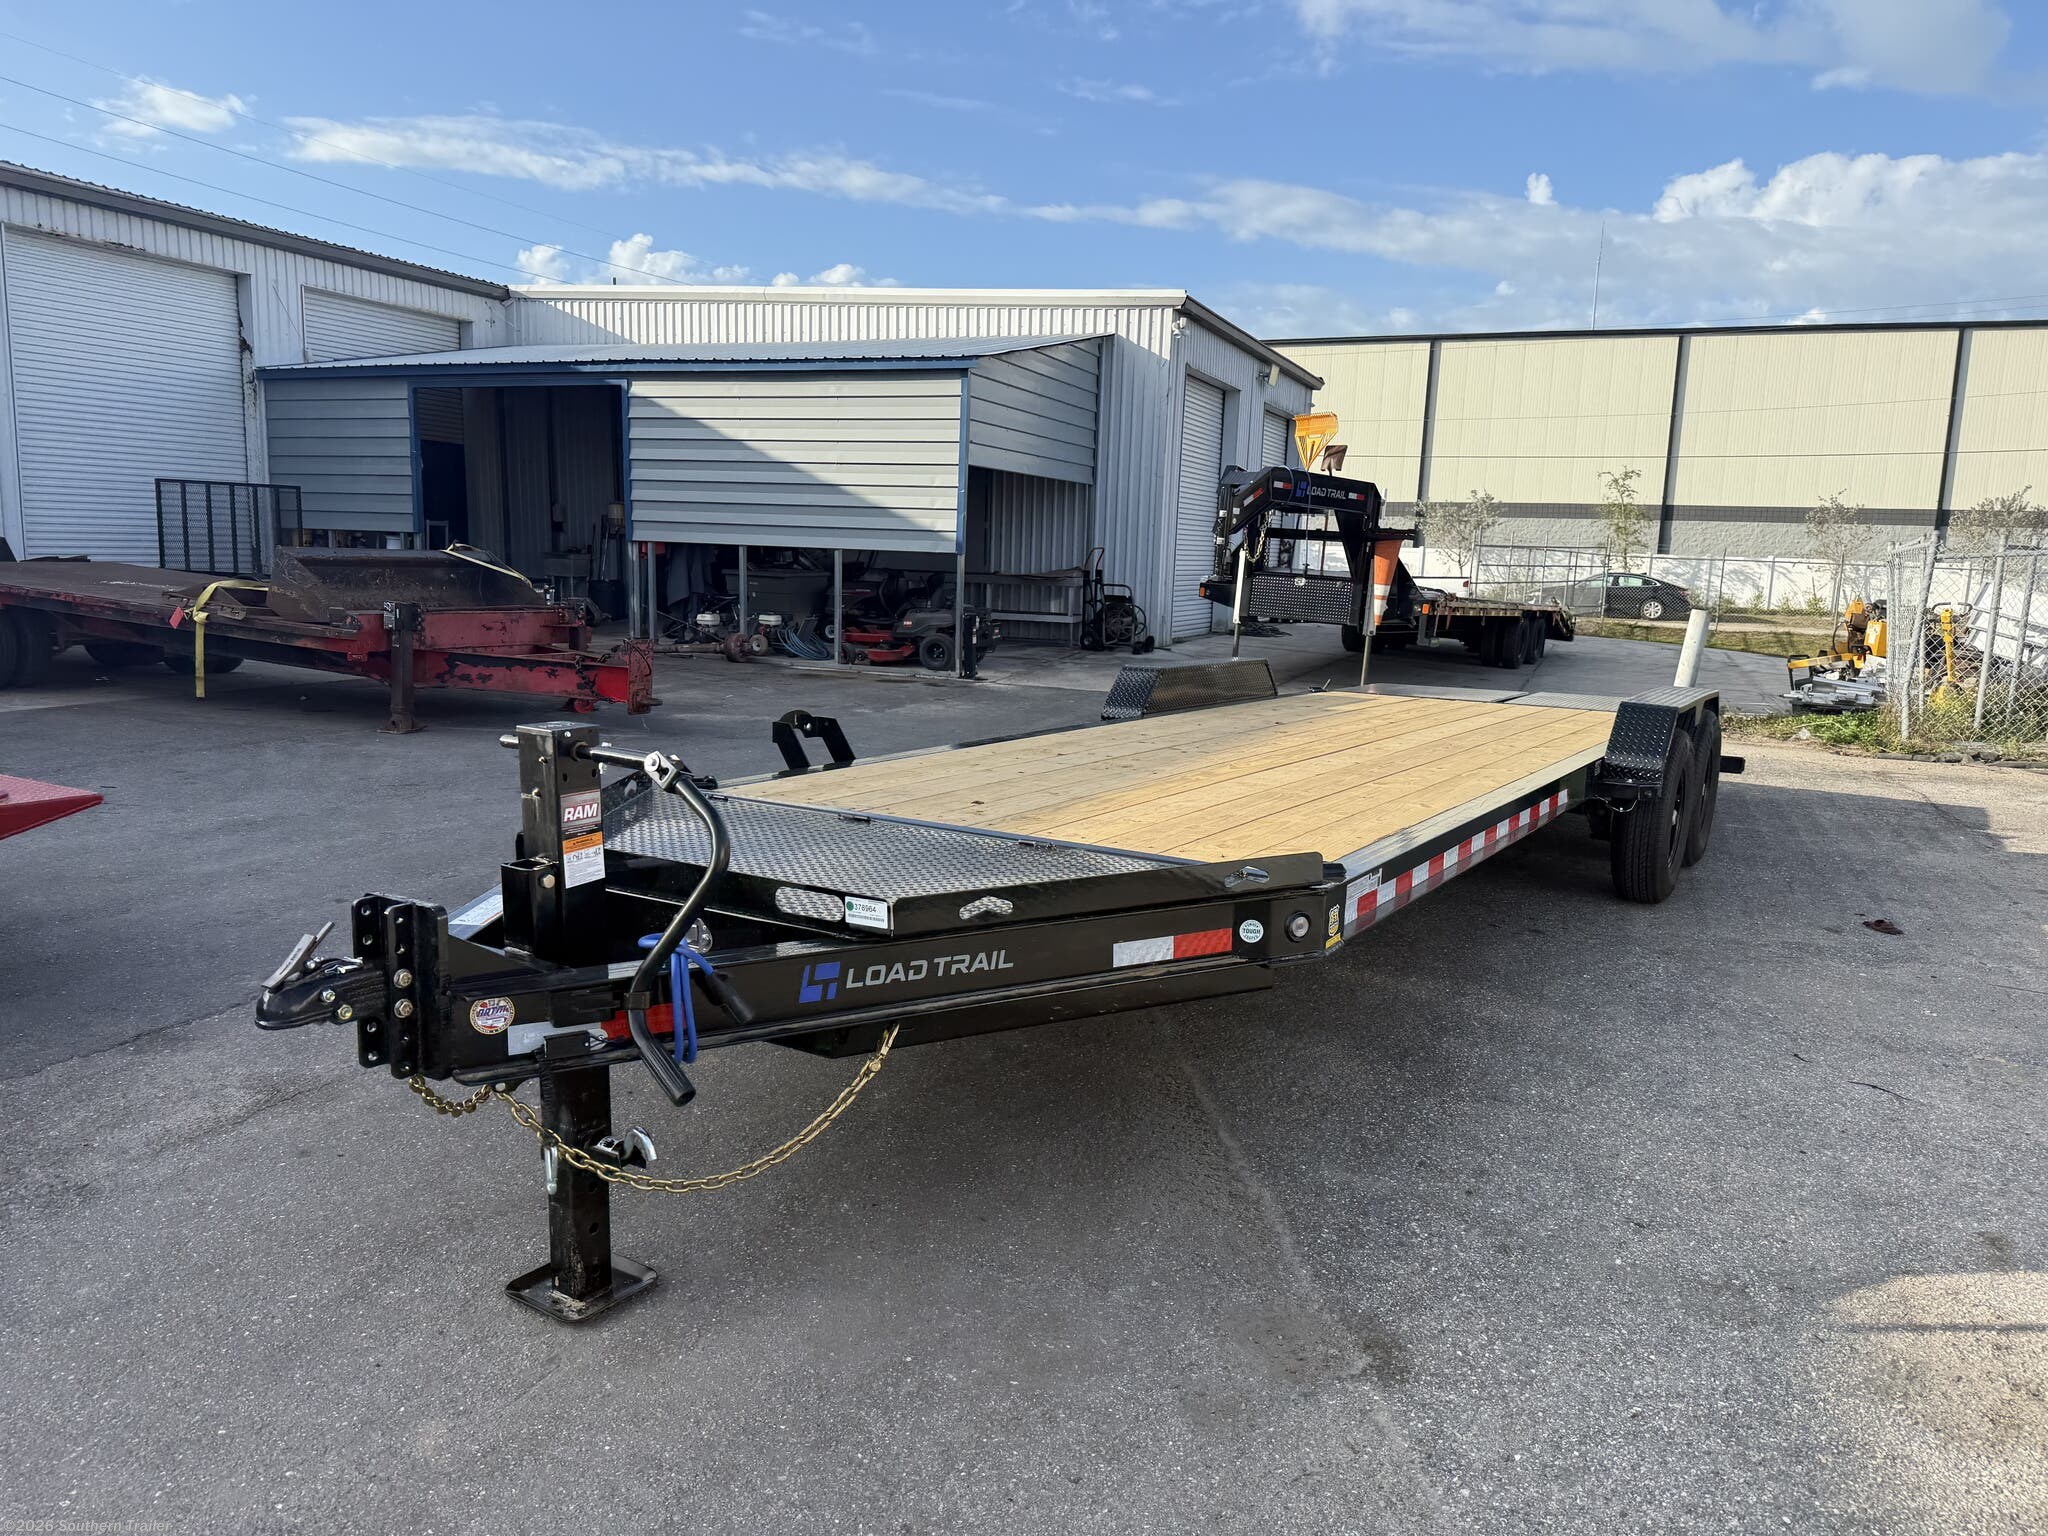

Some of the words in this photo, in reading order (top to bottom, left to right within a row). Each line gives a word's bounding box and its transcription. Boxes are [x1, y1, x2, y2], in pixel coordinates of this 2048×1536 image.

[1306, 486, 1326, 497] LOAD
[1327, 488, 1346, 499] TRAIL
[563, 803, 598, 822] RAM
[846, 959, 928, 989] LOAD
[933, 950, 1014, 977] TRAIL
